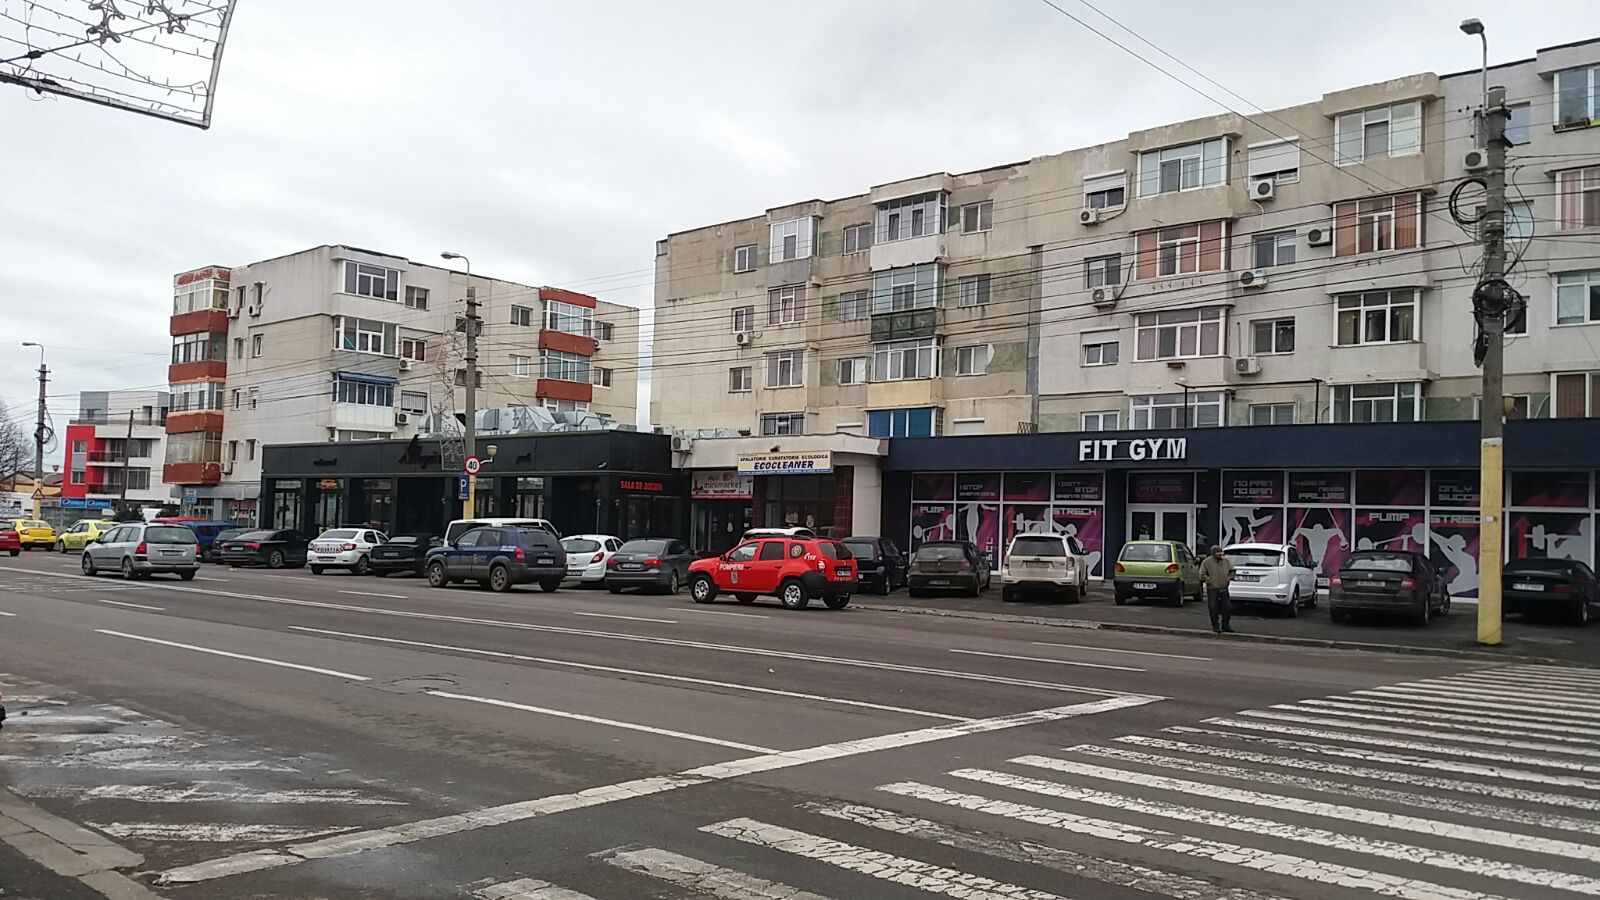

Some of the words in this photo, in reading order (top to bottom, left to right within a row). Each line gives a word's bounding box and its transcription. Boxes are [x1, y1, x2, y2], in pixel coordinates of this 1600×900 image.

[1079, 440, 1118, 461] FIT
[1129, 438, 1187, 460] GYM
[468, 461, 478, 470] 40
[754, 460, 814, 470] ECOCLEANER
[460, 479, 467, 493] P
[1053, 508, 1097, 516] STRECH
[1369, 513, 1410, 521] PUMP
